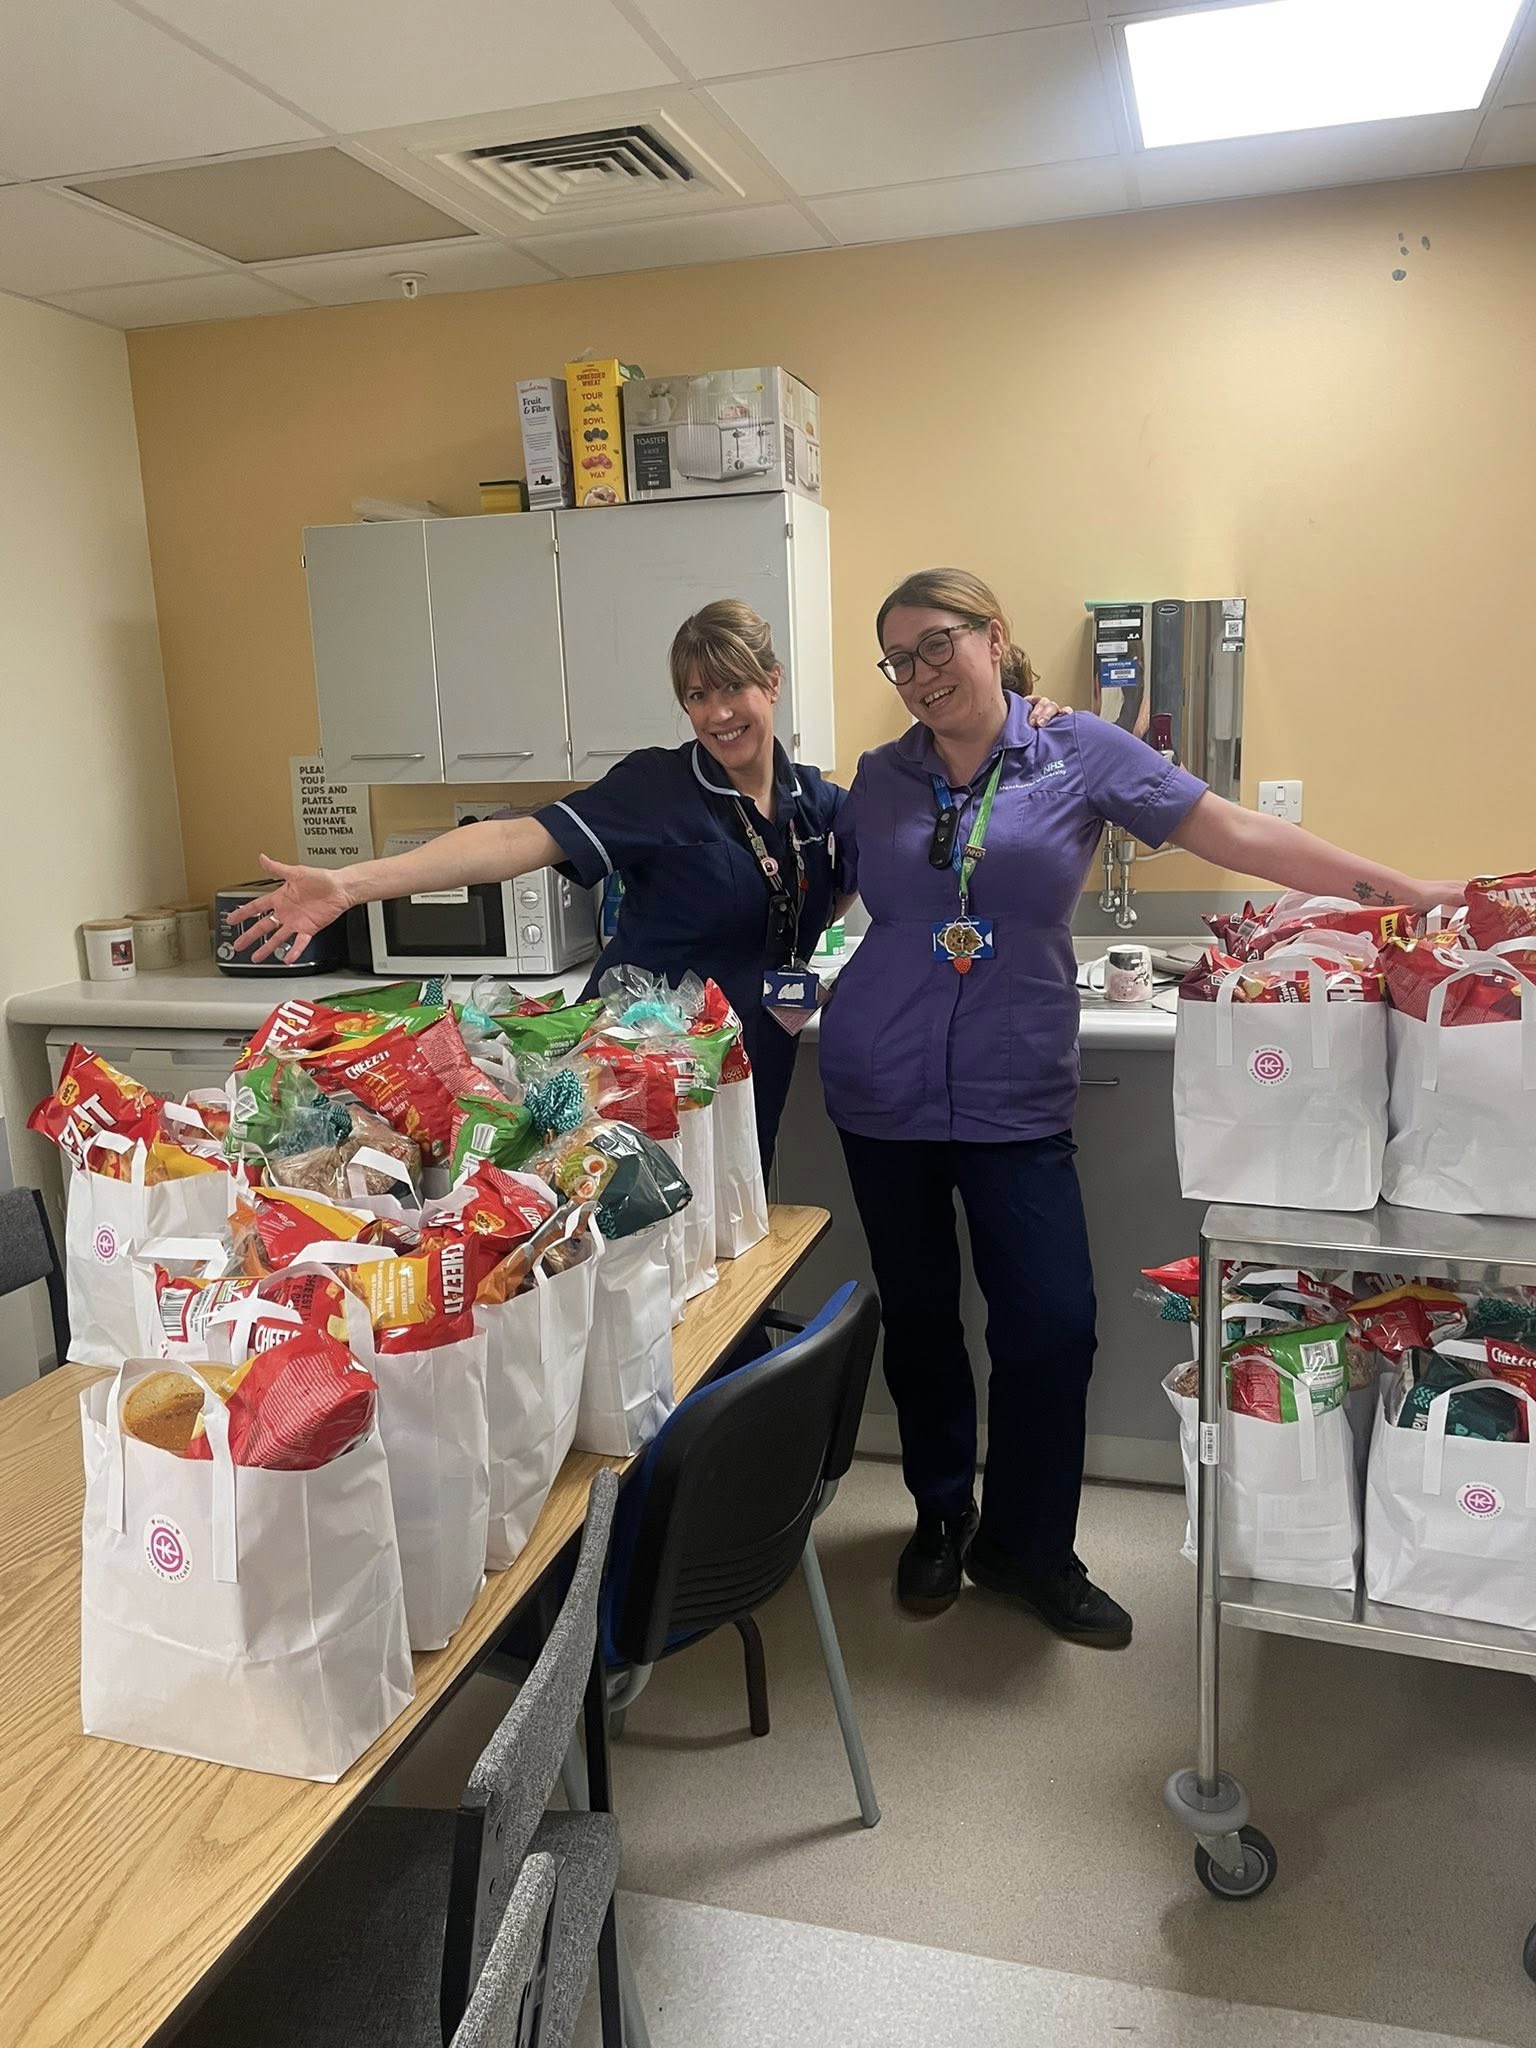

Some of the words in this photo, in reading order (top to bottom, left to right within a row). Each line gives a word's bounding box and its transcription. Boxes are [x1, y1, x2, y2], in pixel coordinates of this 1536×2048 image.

[582, 392, 603, 400] YOUR
[522, 397, 542, 406] Fruit
[532, 405, 550, 413] Fibre
[584, 417, 606, 426] BOWL
[636, 436, 666, 446] TOASTER
[586, 444, 606, 452] YOUR
[1043, 760, 1064, 774] NHS
[300, 776, 318, 784] YOU
[301, 786, 325, 794] CUPS
[328, 786, 348, 794] AND
[302, 796, 334, 805] PLATES
[302, 807, 328, 815] AWAY
[330, 806, 357, 814] AFTER
[303, 818, 320, 826] YOU
[304, 828, 328, 836] USED
[330, 827, 354, 835] THEM
[307, 847, 337, 855] THANK
[441, 1243, 465, 1314] CHEEZ-IT
